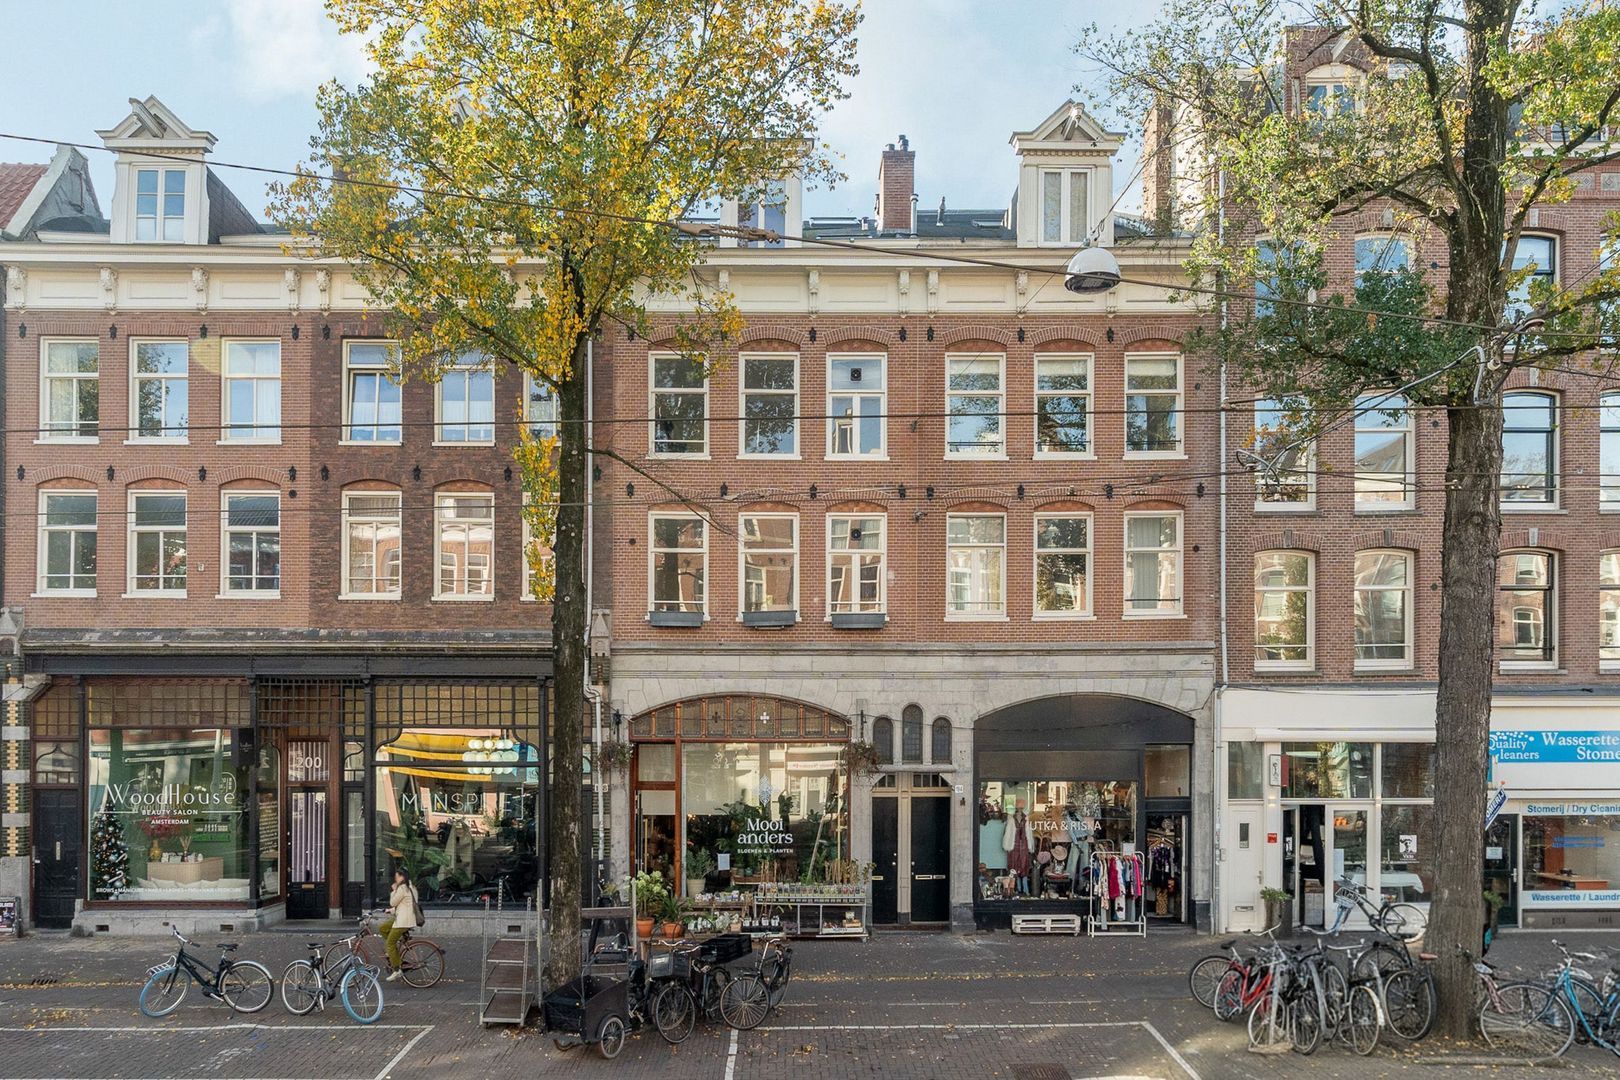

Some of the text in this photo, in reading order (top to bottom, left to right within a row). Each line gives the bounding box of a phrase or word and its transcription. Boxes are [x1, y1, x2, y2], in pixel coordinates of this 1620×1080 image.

[1488, 737, 1527, 750] Quality
[1541, 732, 1620, 746] Wasserette
[1495, 749, 1540, 760] leaners
[1576, 747, 1620, 760] Stome
[296, 757, 322, 769] 200
[106, 783, 236, 805] WoodHouse
[402, 793, 513, 812] MNSPIE
[1527, 804, 1565, 814] Stomerij
[1572, 804, 1588, 814] Dry
[747, 818, 784, 831] Mooi
[1060, 820, 1069, 831] &
[737, 831, 794, 844] anders
[1531, 893, 1581, 902] Wasserette
